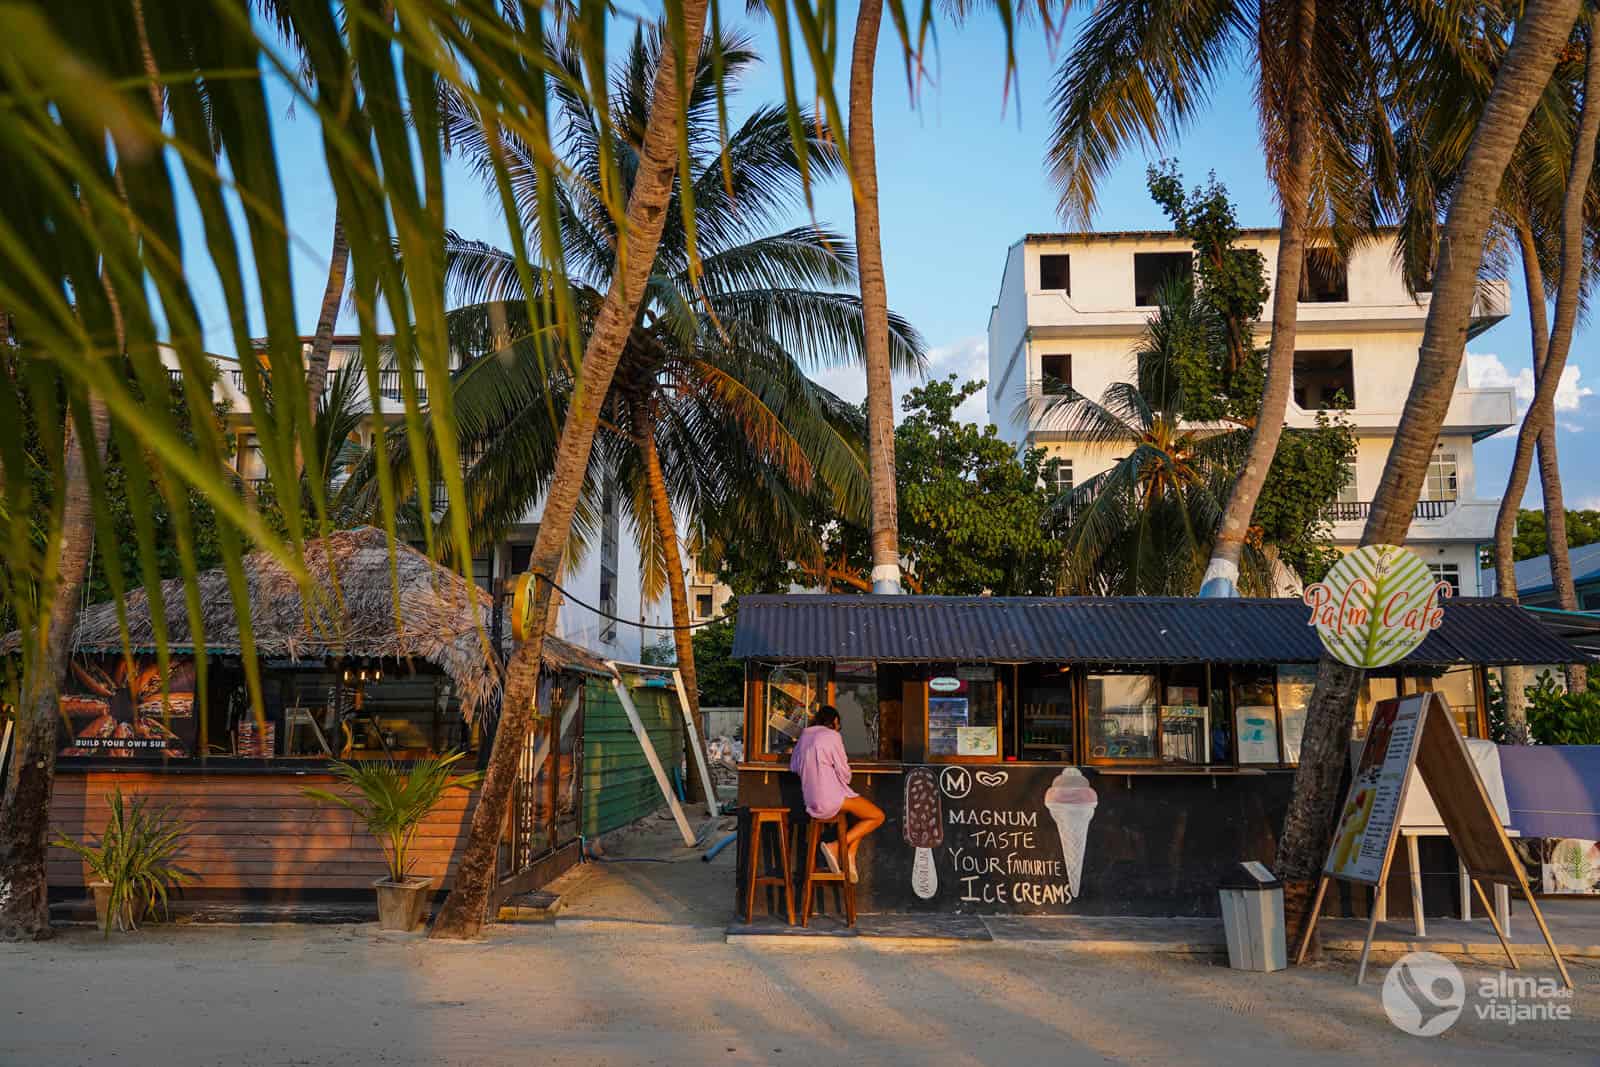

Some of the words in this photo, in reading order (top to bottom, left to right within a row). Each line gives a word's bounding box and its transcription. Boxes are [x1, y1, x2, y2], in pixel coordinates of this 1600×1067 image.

[1375, 553, 1392, 577] the
[1304, 578, 1369, 635] Palm
[75, 739, 100, 747] BUILD
[102, 739, 124, 747] YOUR
[946, 772, 965, 792] M
[948, 809, 1037, 827] MAGNUM
[969, 830, 1036, 849] TASTE
[948, 847, 1006, 875] YOUR
[959, 875, 1007, 902] ICE
[1012, 882, 1072, 905] CREAMS
